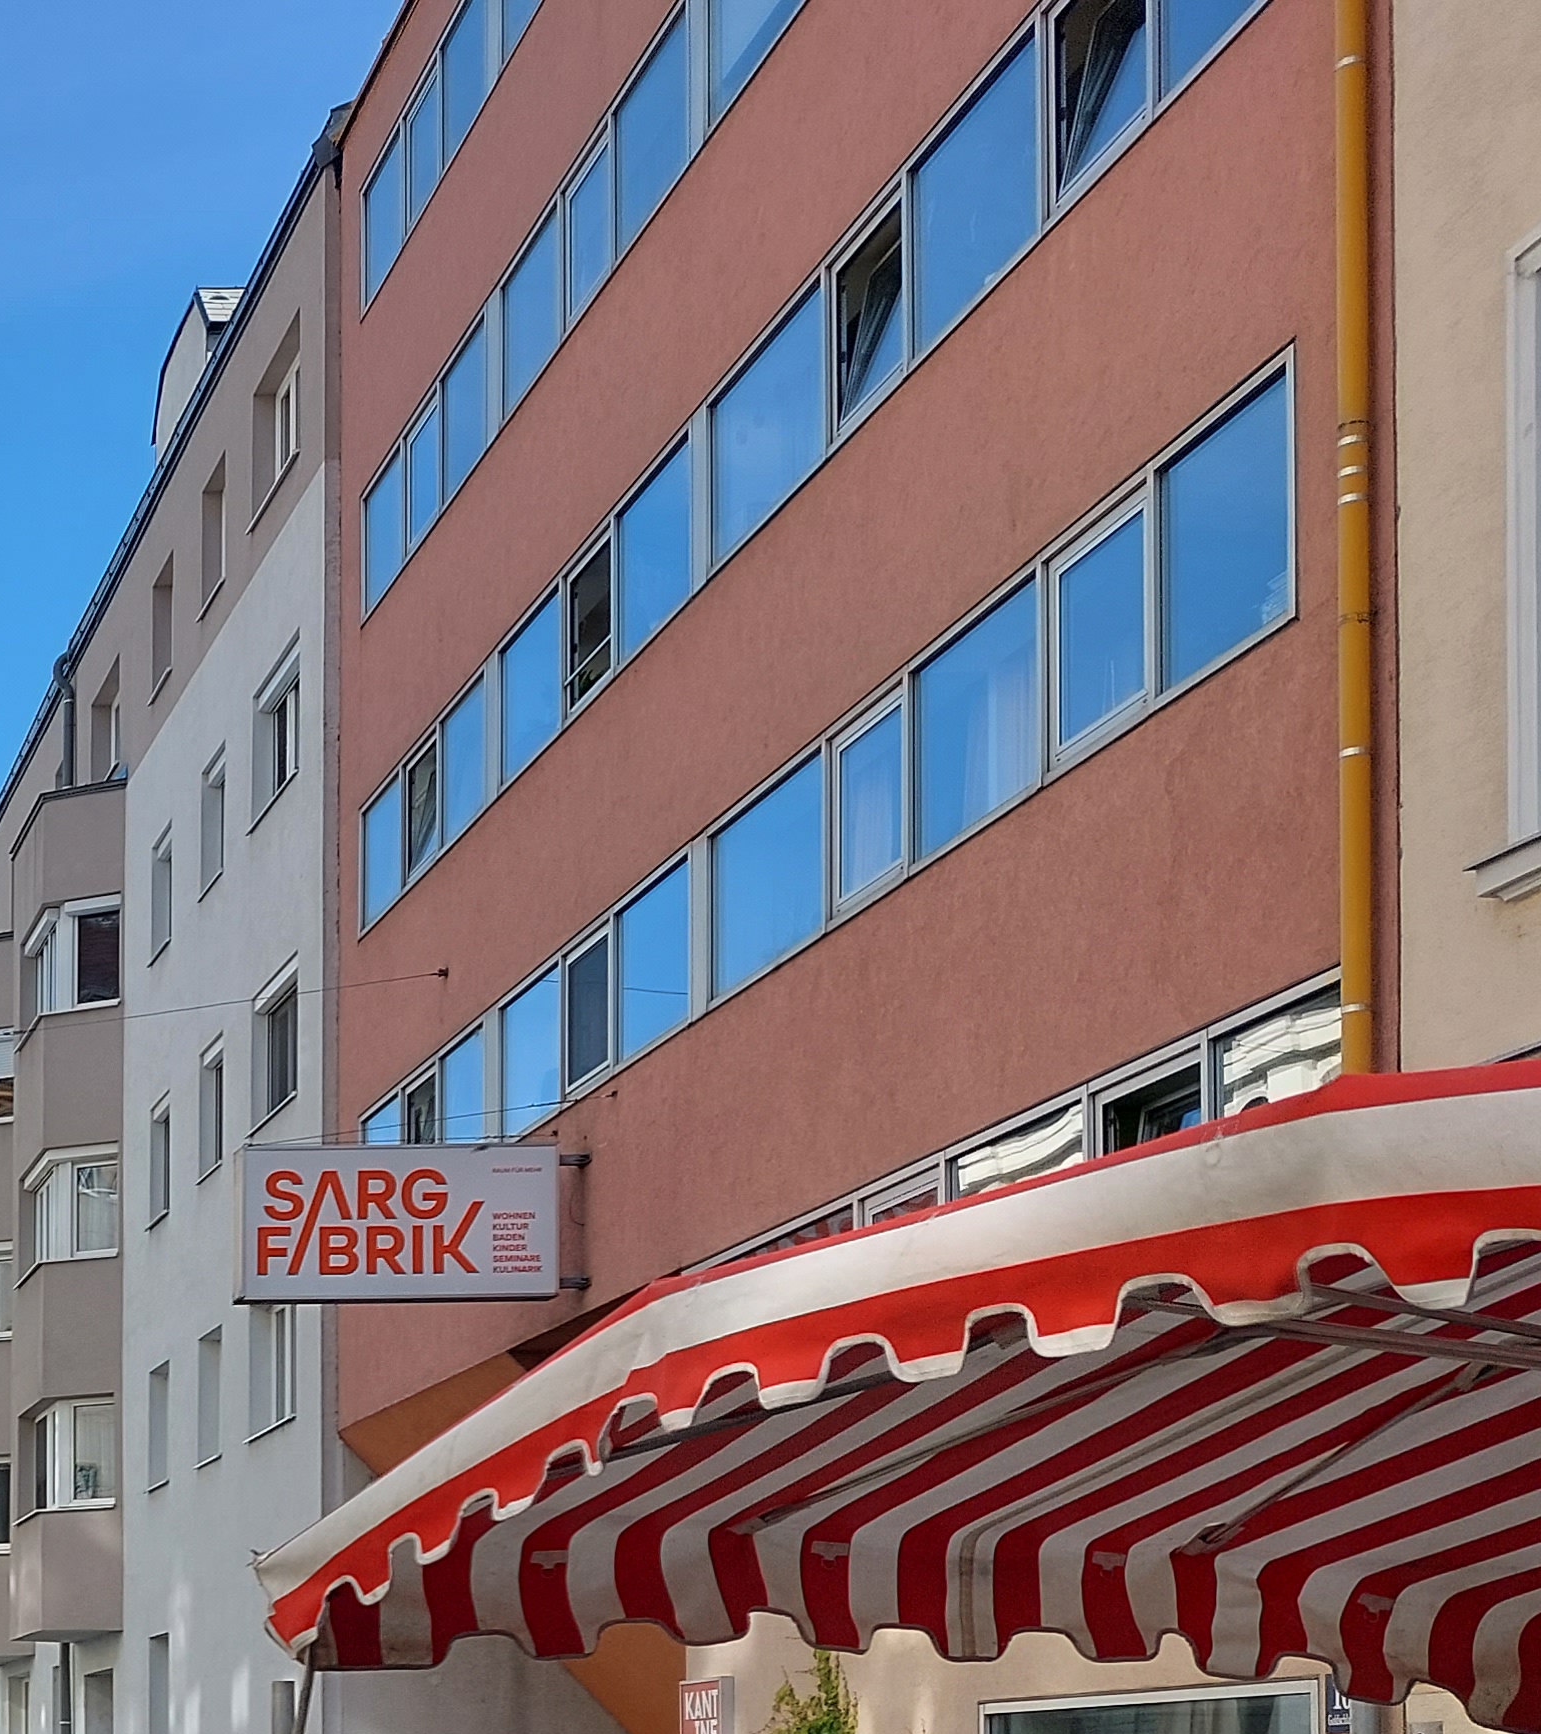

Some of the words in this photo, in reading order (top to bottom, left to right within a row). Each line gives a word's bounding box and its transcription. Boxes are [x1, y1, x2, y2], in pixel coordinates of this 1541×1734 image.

[263, 1168, 449, 1221] SARG
[492, 1212, 536, 1220] WOHNEN
[492, 1223, 529, 1231] KULTUR
[492, 1233, 525, 1241] BADEN
[492, 1244, 527, 1252] KINDER
[492, 1254, 541, 1263] SEMINARE
[492, 1265, 543, 1273] KULINARIK
[684, 1689, 718, 1721] KANT
